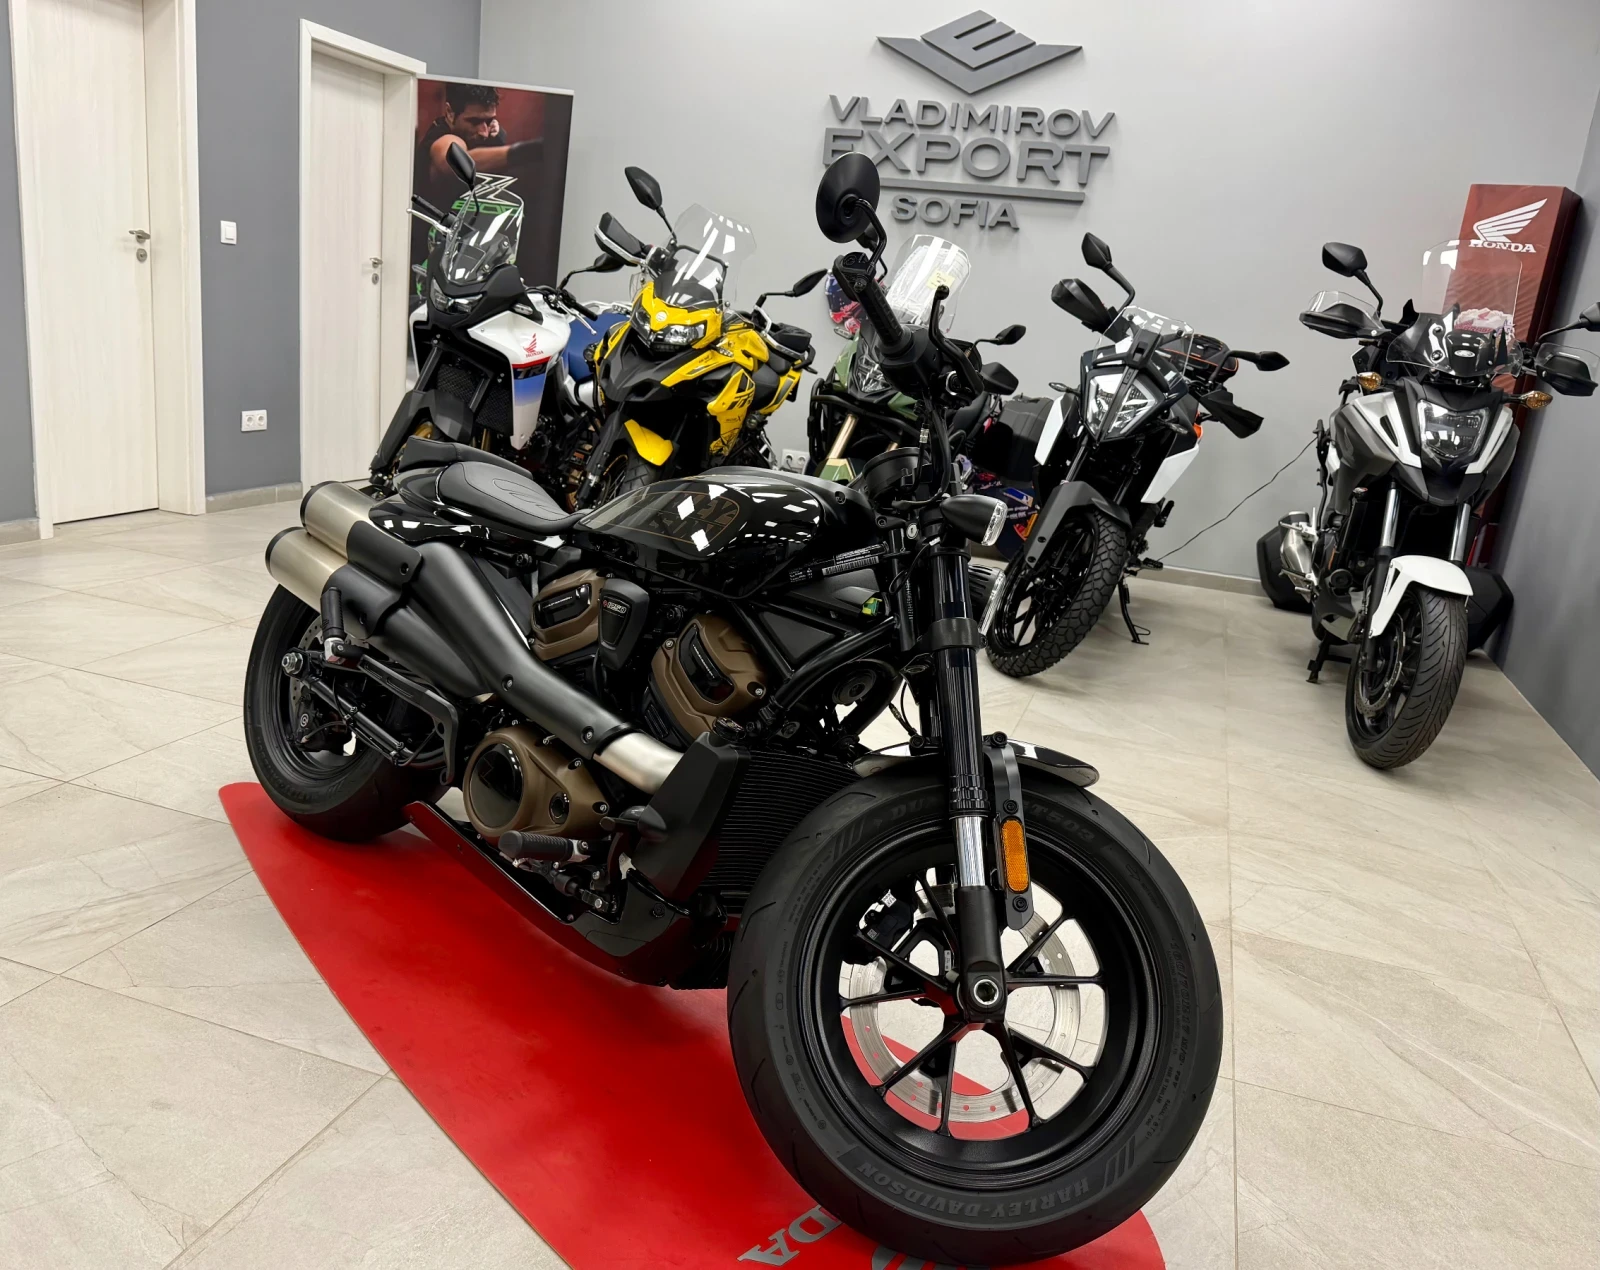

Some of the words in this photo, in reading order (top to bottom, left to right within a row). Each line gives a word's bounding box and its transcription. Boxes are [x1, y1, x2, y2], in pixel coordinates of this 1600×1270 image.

[829, 94, 1115, 138] VLADIMIROV
[822, 127, 1110, 185] EXPORT
[891, 193, 1020, 230] SOFIA
[1468, 239, 1537, 253] HONDA
[855, 1161, 1090, 1220] HARLEY-DAVIDSON
